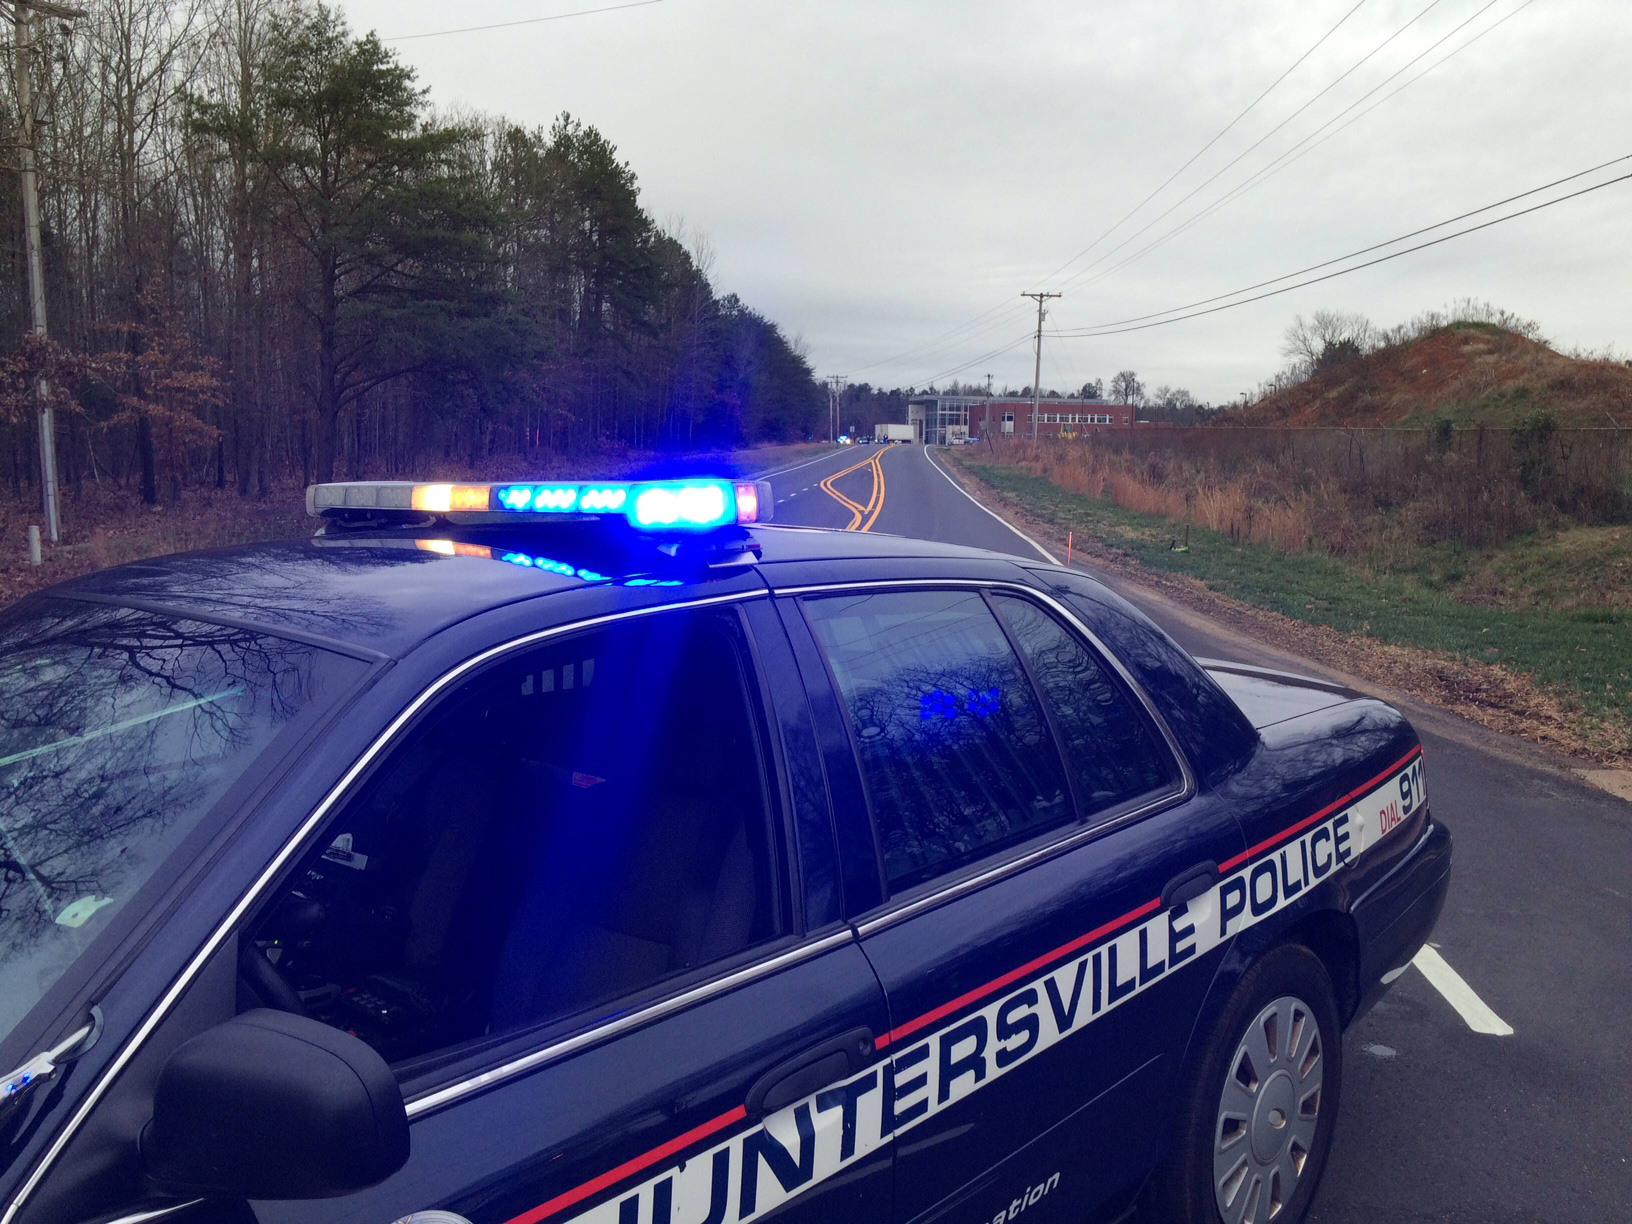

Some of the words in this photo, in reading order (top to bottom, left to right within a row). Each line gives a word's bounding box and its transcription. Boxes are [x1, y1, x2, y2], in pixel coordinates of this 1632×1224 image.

[1379, 800, 1402, 835] DIAL
[1399, 757, 1426, 816] 911
[619, 902, 1197, 1224] UNTERSVILLE
[1219, 812, 1352, 939] POLICE
[985, 1172, 1060, 1224] ation
